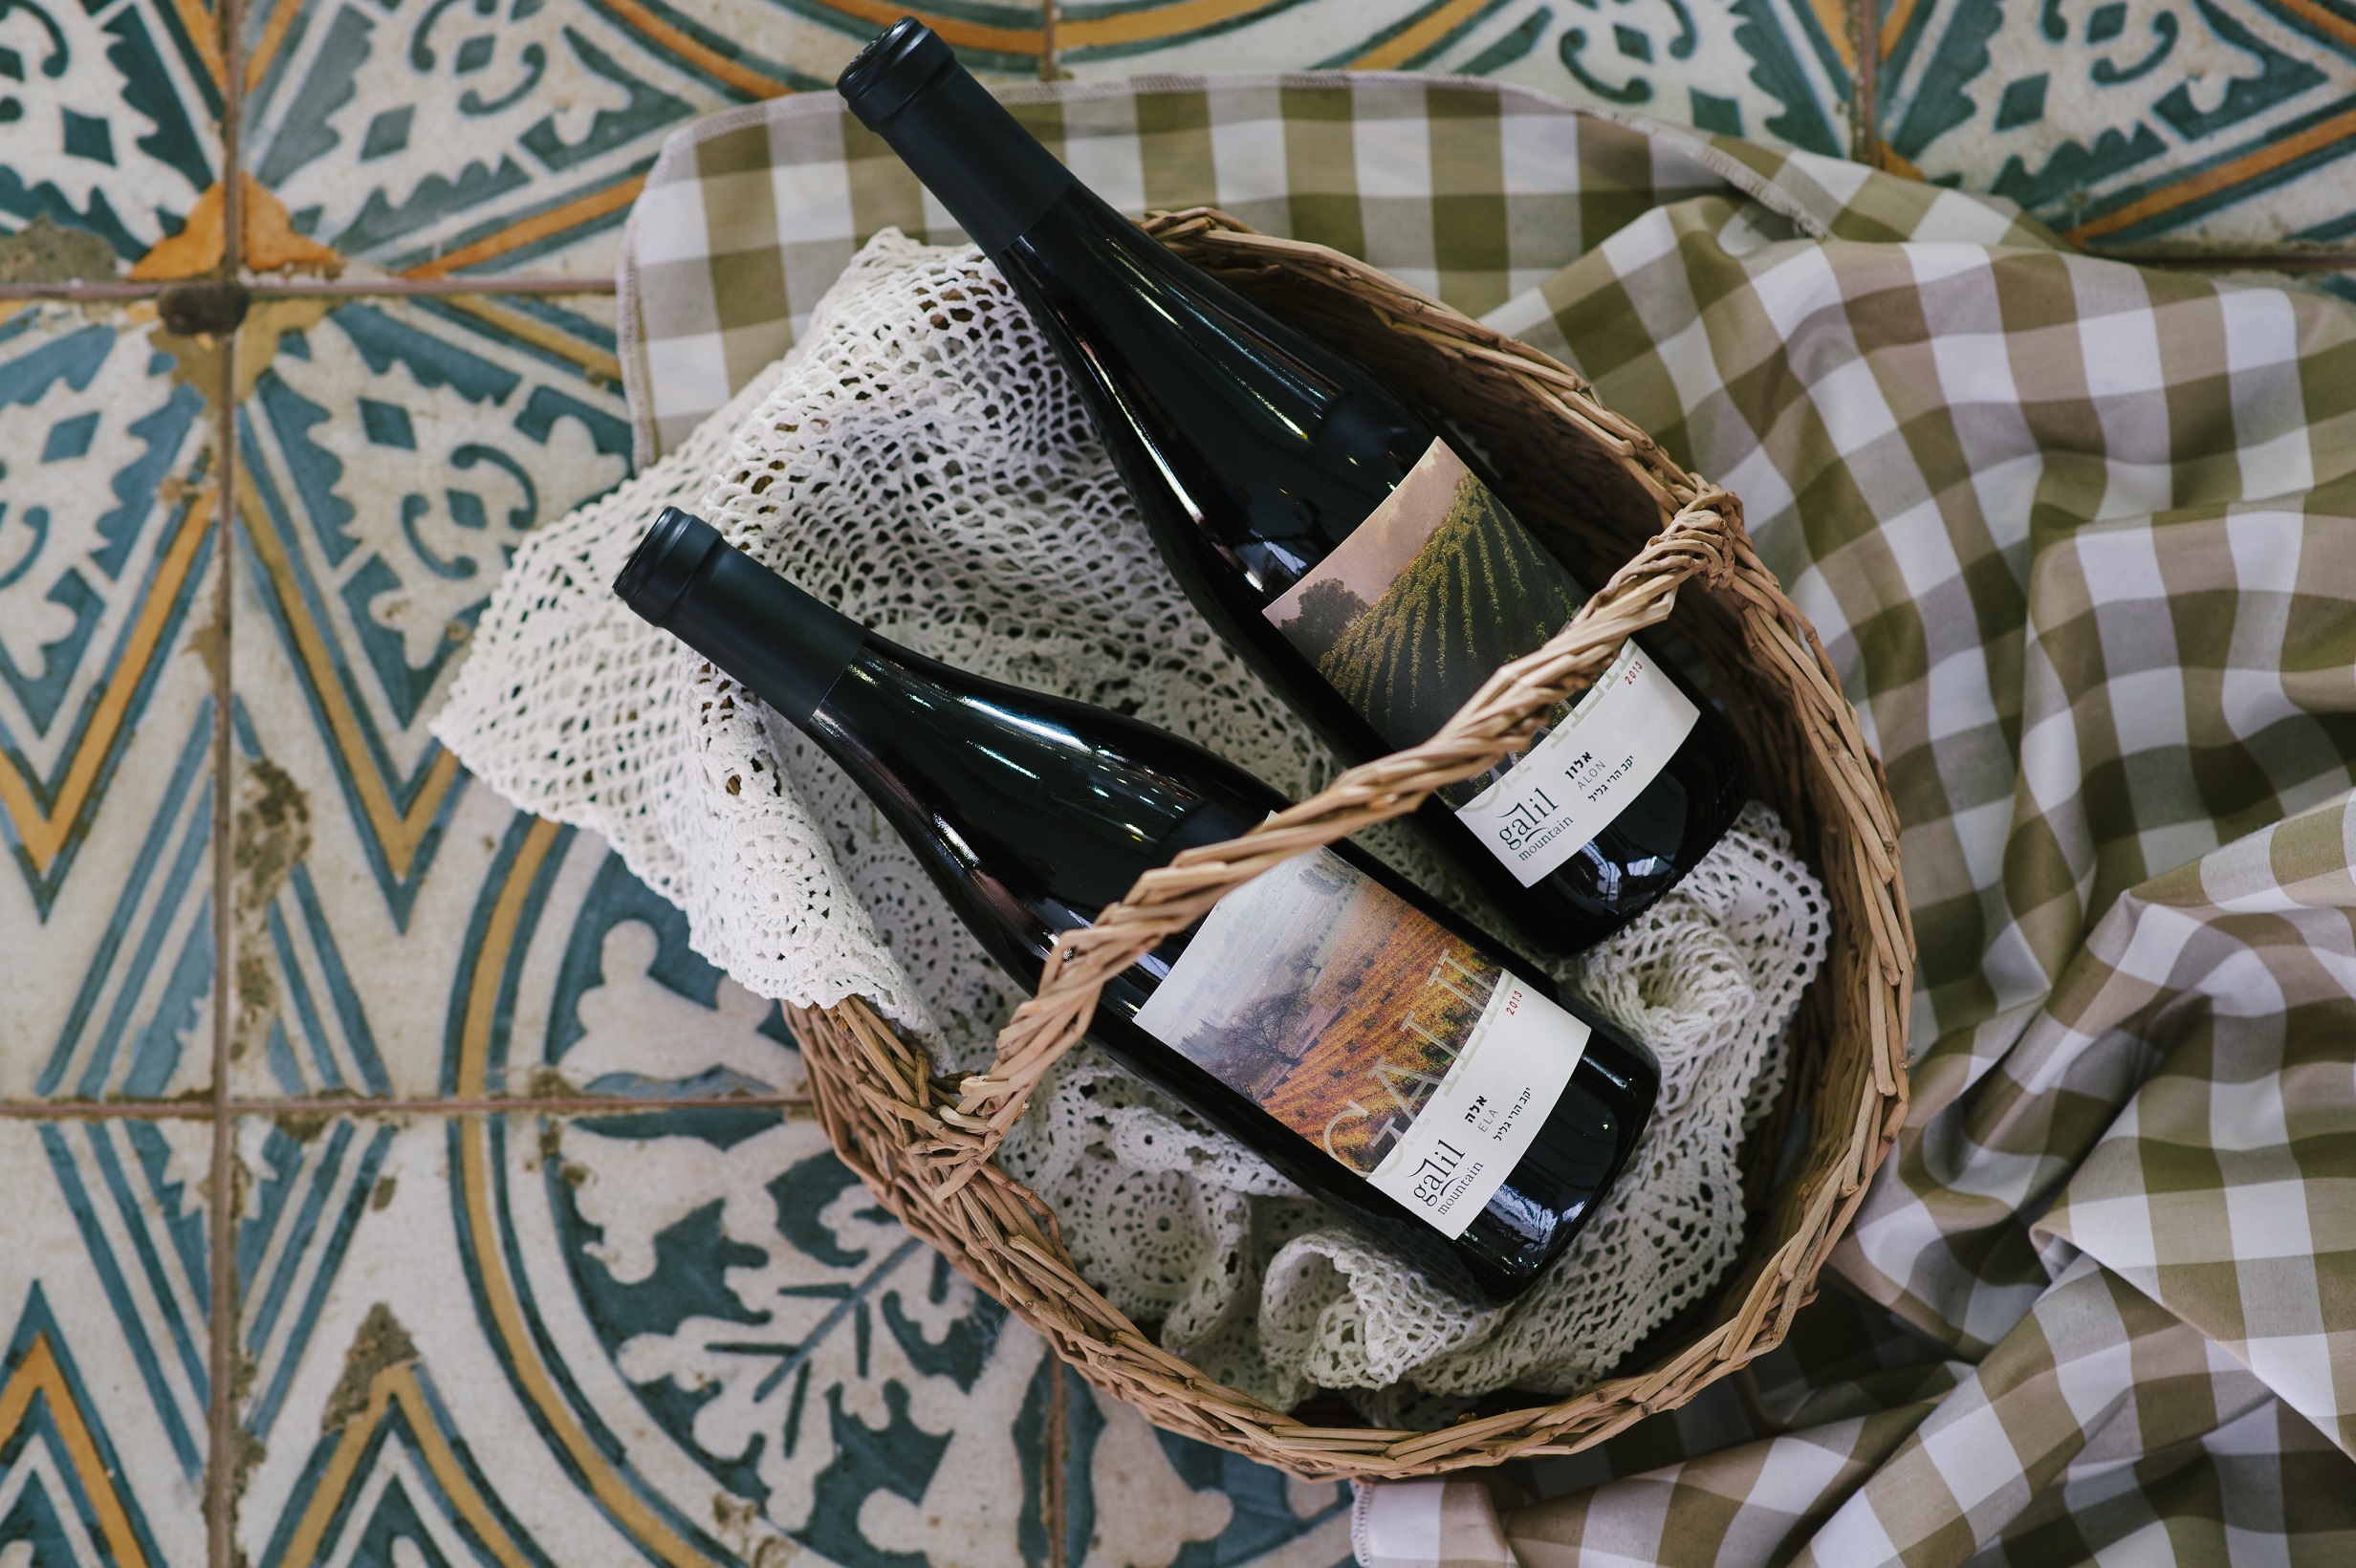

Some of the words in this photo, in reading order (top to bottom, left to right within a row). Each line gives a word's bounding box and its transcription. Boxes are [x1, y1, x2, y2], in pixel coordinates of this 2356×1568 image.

[1564, 751, 1593, 779] אלון
[1577, 760, 1605, 790] ALON
[1606, 770, 1623, 783] הרי
[1621, 755, 1634, 772] יקב
[1587, 784, 1608, 802] גליל
[1496, 787, 1560, 851] galil
[1518, 817, 1574, 861] mountain
[1505, 990, 1523, 1016] 2013
[1518, 1087, 1532, 1104] יקב
[1464, 1095, 1488, 1123] אלה
[1477, 1108, 1498, 1133] ELA
[1508, 1104, 1523, 1120] הרי
[1493, 1121, 1512, 1142] גליל
[1406, 1139, 1466, 1208] galil
[1437, 1162, 1485, 1215] mountain
